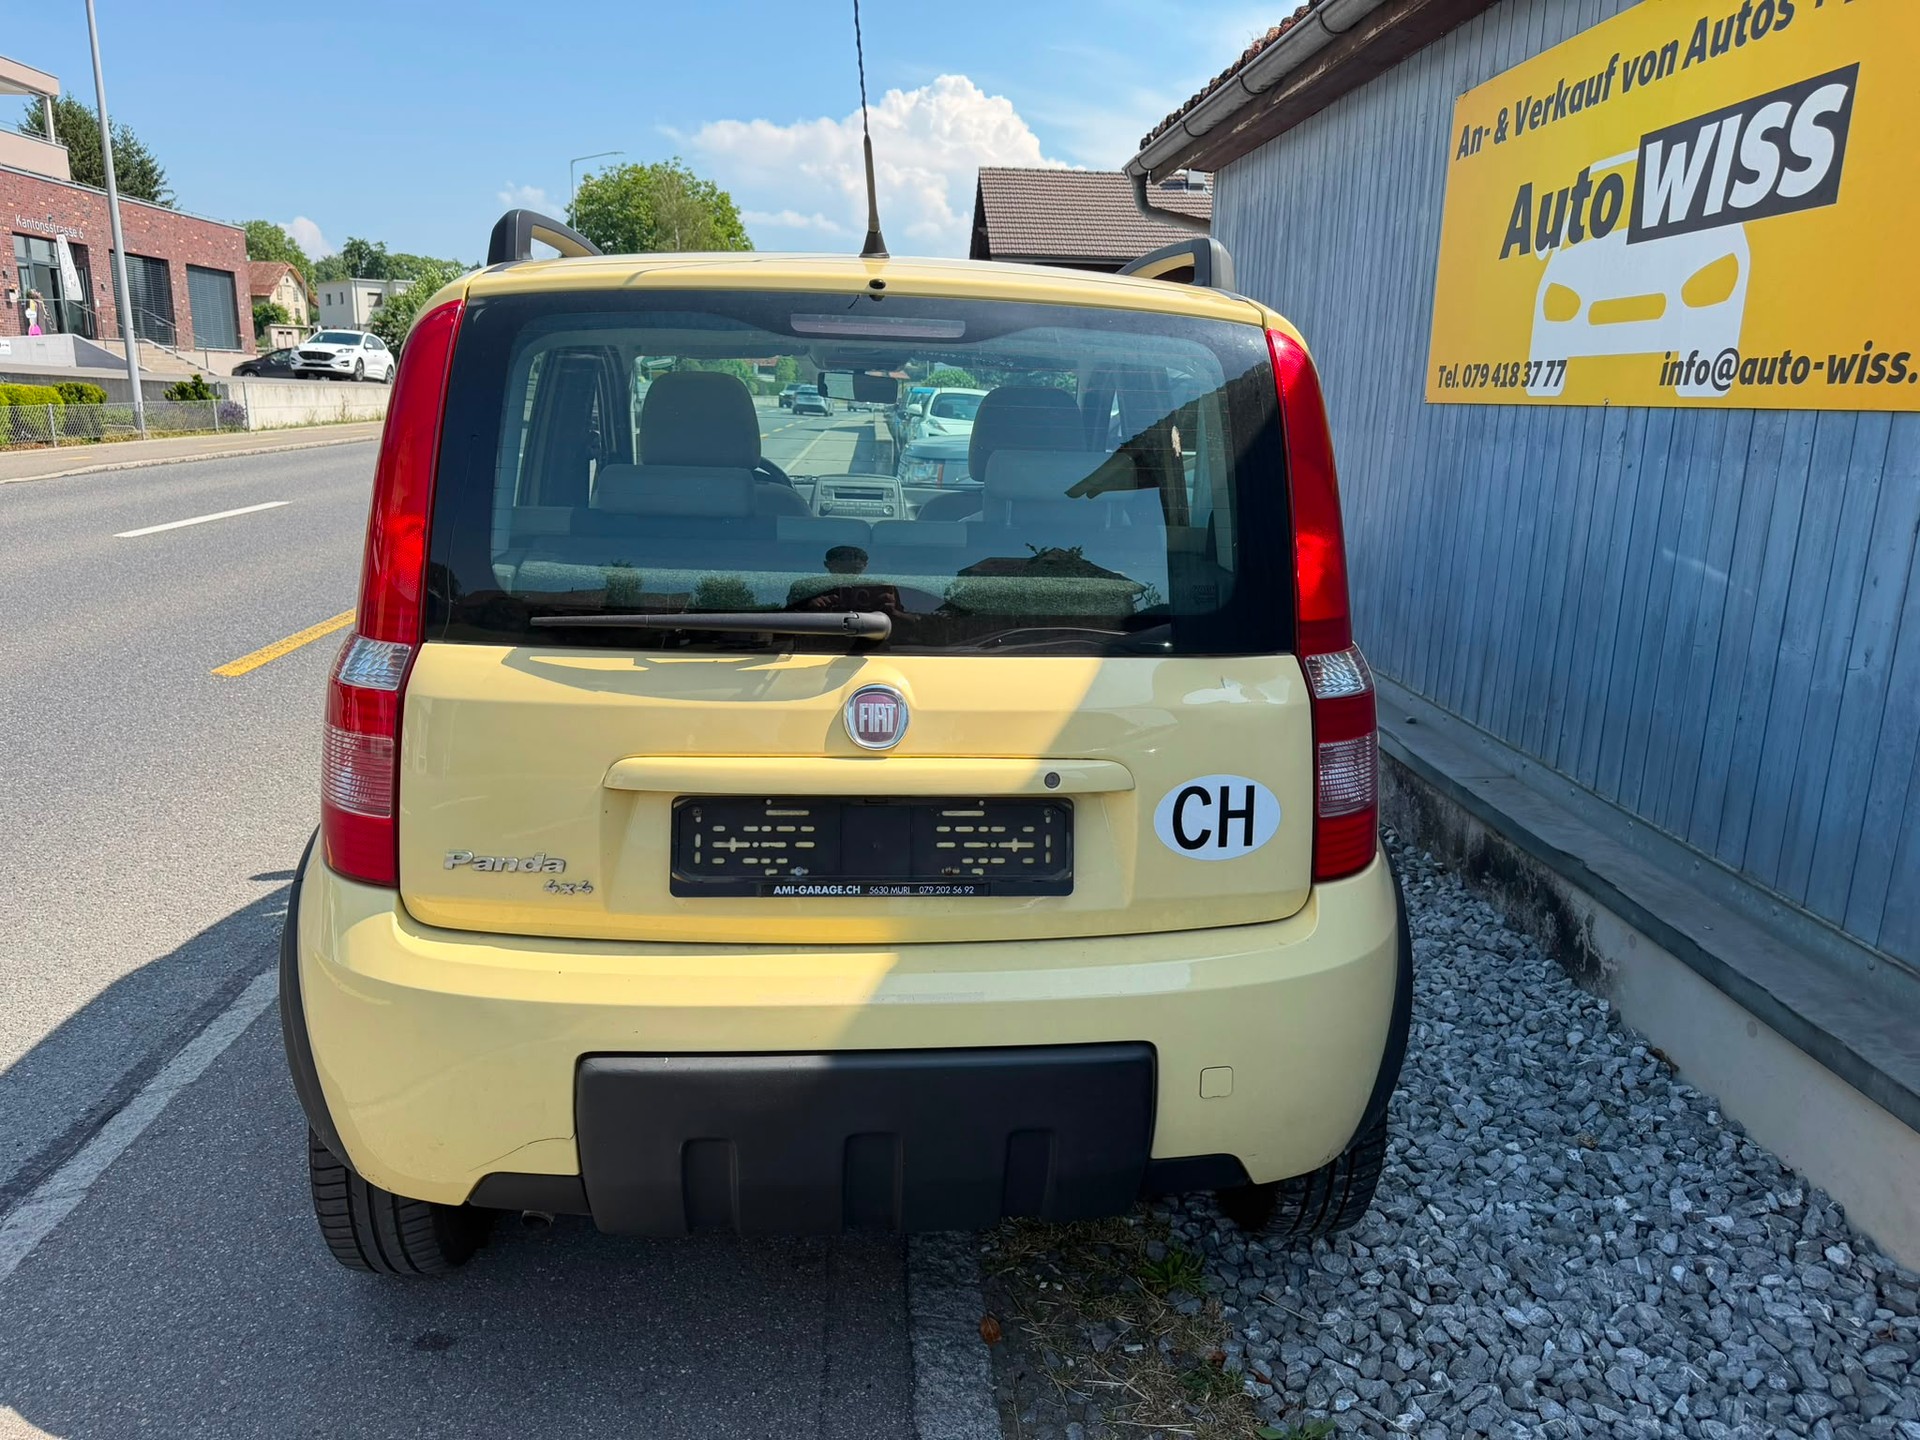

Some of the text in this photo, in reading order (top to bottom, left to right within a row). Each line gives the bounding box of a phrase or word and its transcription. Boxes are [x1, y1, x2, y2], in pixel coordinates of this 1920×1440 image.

[1456, 0, 1795, 161] An- & Verkauf von Autos
[1499, 83, 1849, 260] Auto WISS
[14, 213, 84, 240] Kantonsstrasse 6
[1438, 360, 1567, 388] Tel. 079 418 37 77
[1659, 340, 1918, 391] info@auto-wiss.
[859, 703, 897, 733] FIAT
[1172, 785, 1255, 850] CH
[443, 850, 566, 873] Panda
[544, 879, 594, 894] 4x4
[773, 885, 975, 895] AMI-GARAGE.CH 5630 MURI 079 202 56 92
